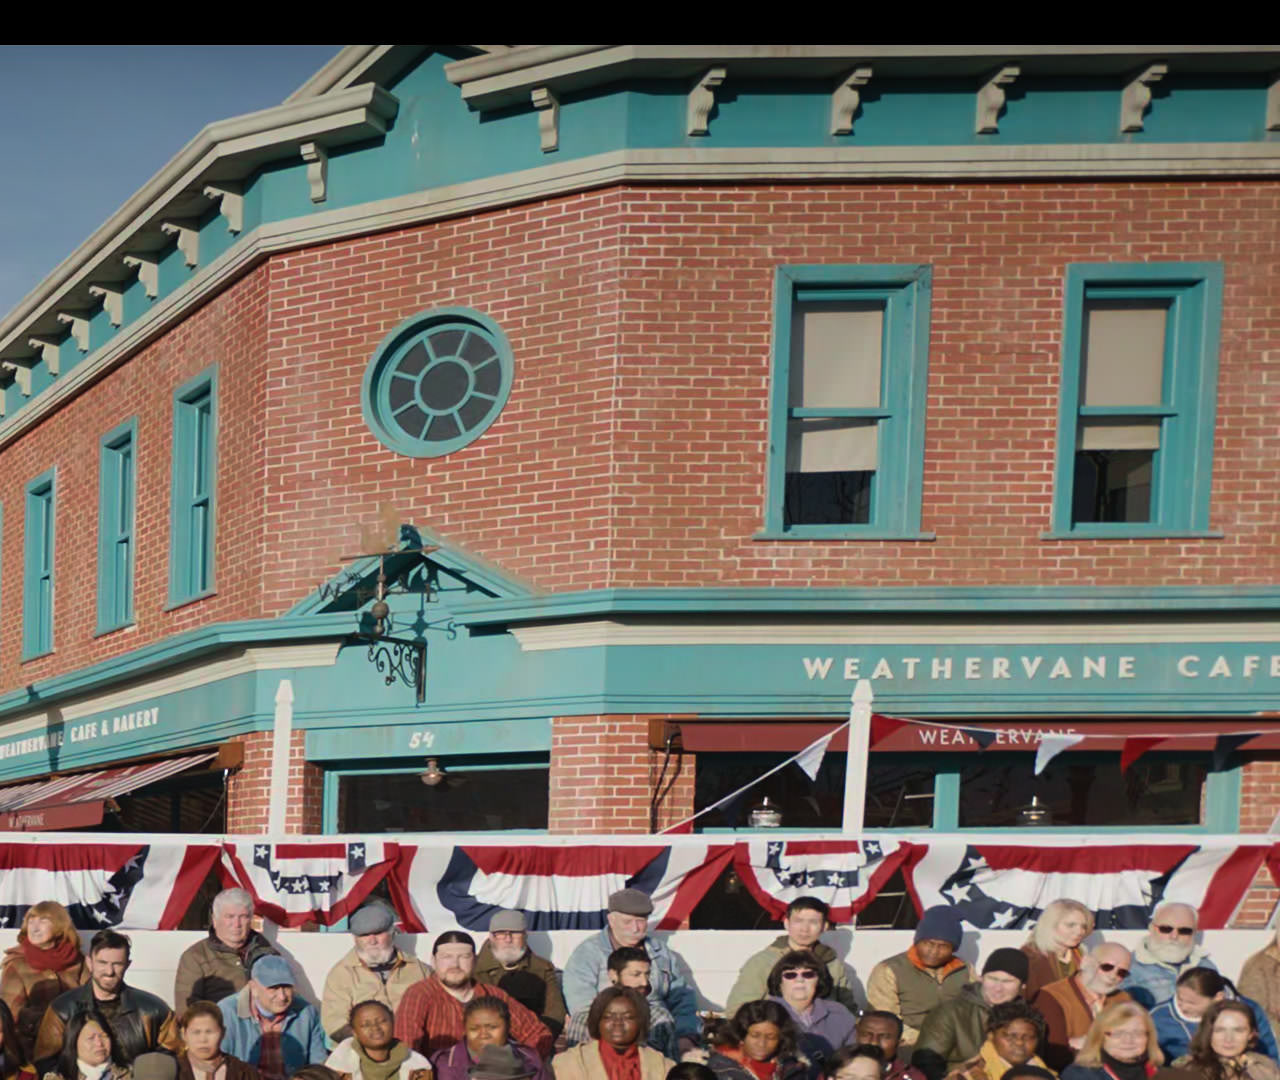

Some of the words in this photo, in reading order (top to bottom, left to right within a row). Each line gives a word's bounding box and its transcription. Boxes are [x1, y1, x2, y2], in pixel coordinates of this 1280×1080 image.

[802, 656, 1137, 680] WEATHERVANE
[1177, 655, 1280, 678] CAFE
[70, 722, 98, 743] CAFE
[113, 707, 160, 734] BAKERY
[408, 731, 436, 749] 54
